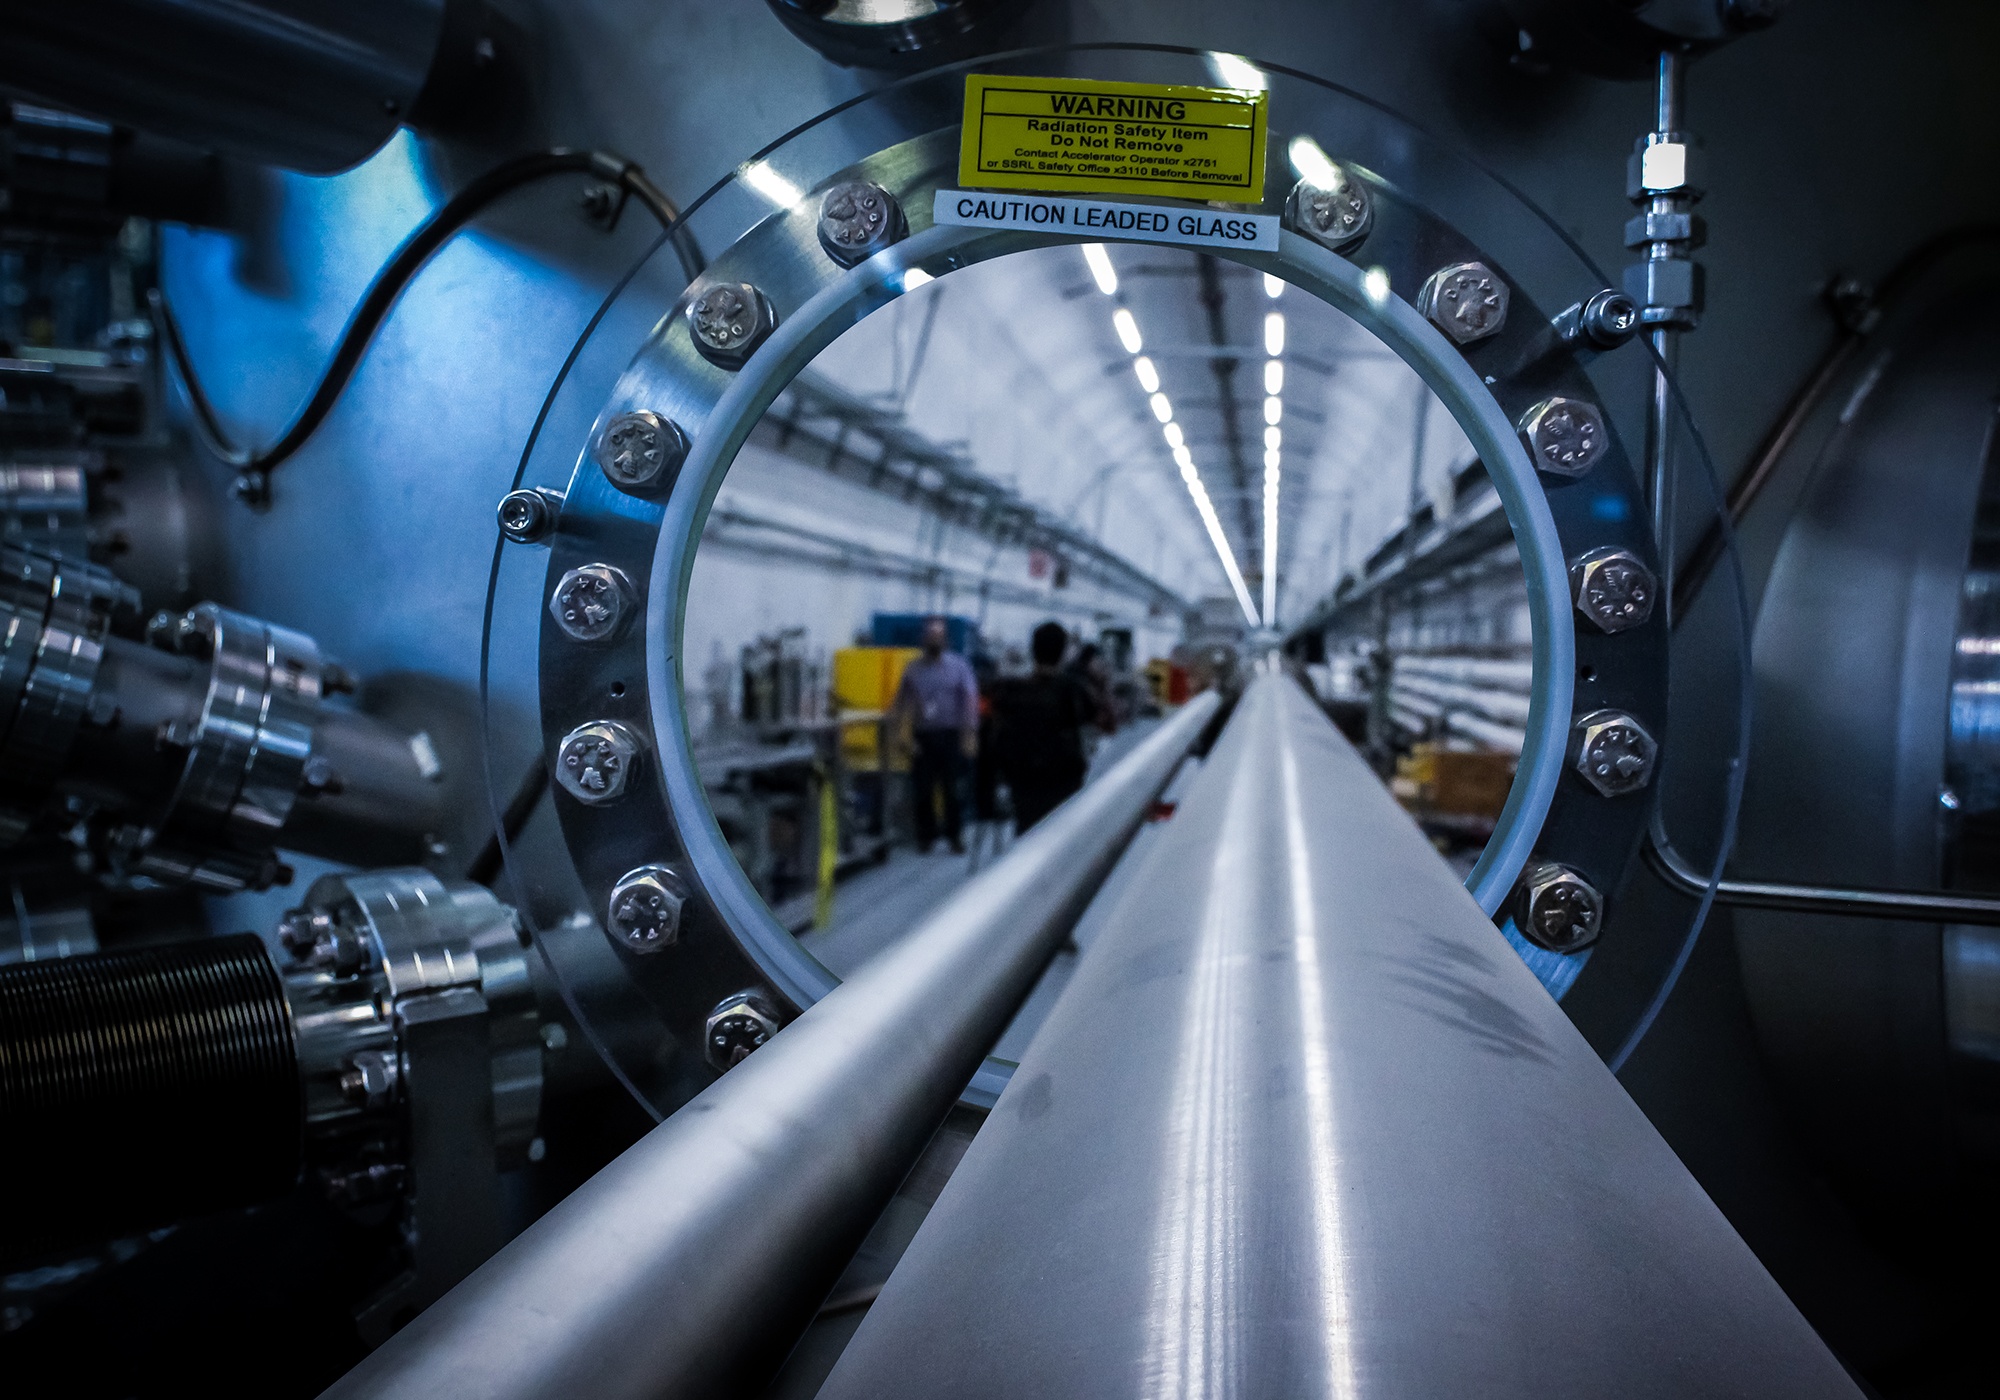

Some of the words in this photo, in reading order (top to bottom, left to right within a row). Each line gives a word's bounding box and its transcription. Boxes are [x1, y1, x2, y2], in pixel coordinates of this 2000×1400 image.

[1050, 95, 1186, 120] WARNING
[1027, 119, 1108, 135] Radiation
[1113, 124, 1167, 140] Safety
[1172, 127, 1209, 141] Item
[1051, 134, 1074, 147] Do
[1079, 136, 1109, 148] Not
[1114, 137, 1184, 153] Remove
[1014, 148, 1059, 159] Contact
[1061, 151, 1126, 163] Accelerator
[1129, 154, 1180, 167] Operator
[1183, 157, 1218, 168] x2751
[986, 160, 999, 169] or
[1002, 159, 1035, 170] SSRL
[1037, 161, 1075, 173] Safety
[1077, 164, 1111, 174] Office
[1113, 166, 1148, 176] x3110
[1151, 168, 1189, 179] Before
[1192, 170, 1243, 182] Removal
[957, 199, 1066, 225] CAUTION
[1073, 207, 1170, 233] LEADED
[1177, 217, 1258, 241] GLASS
